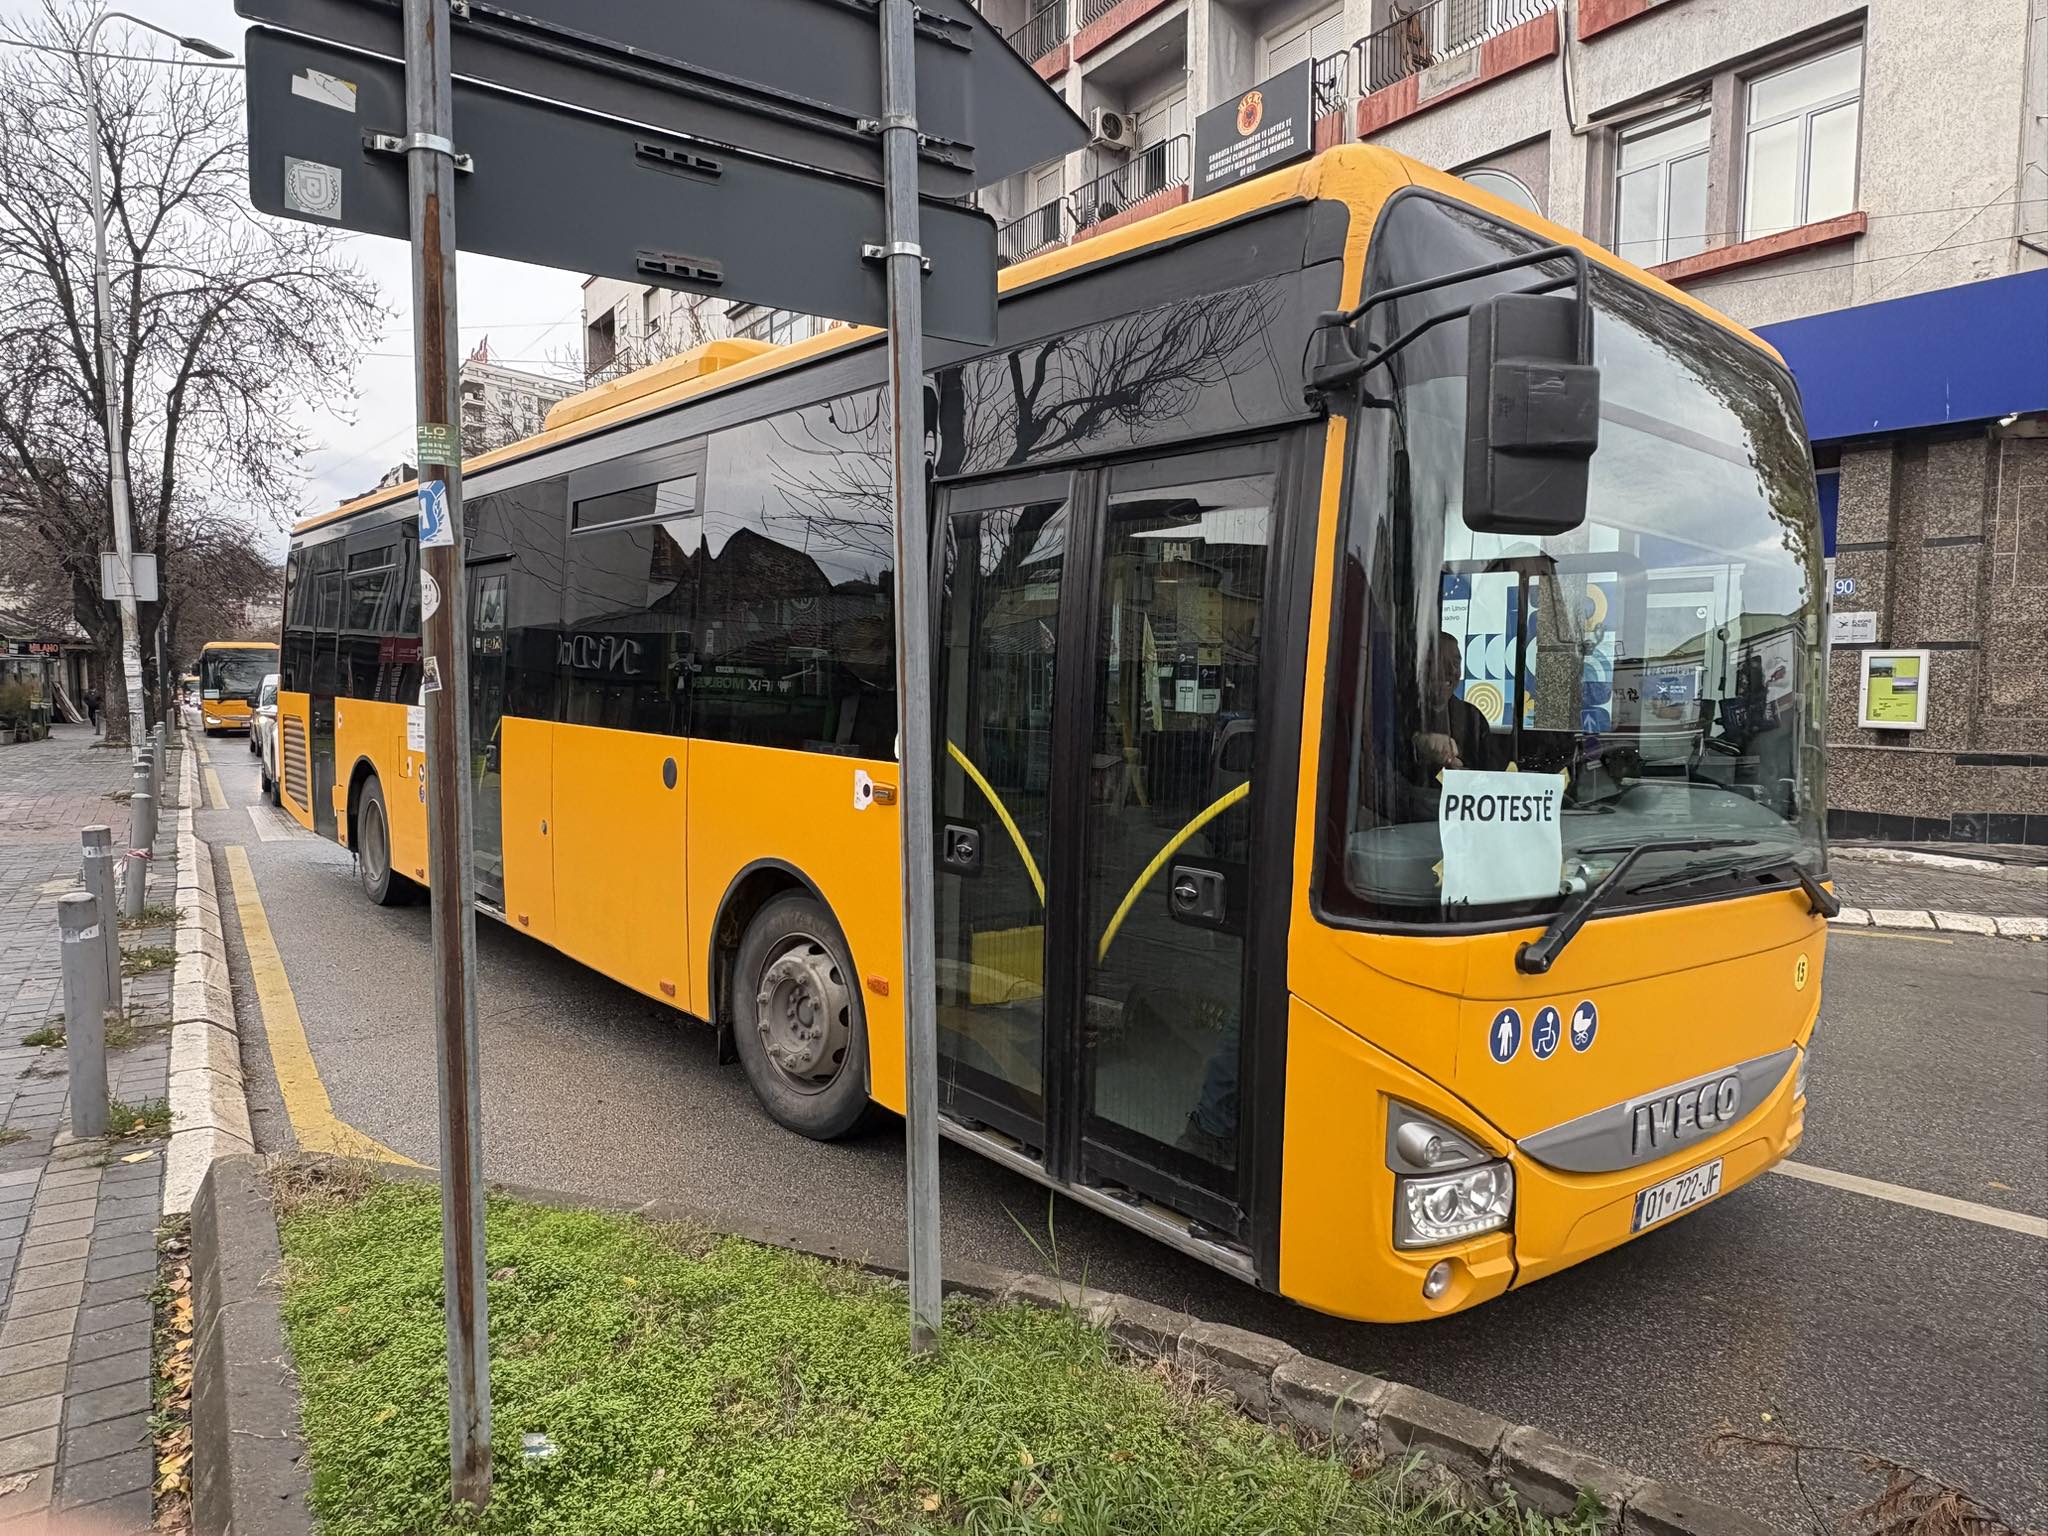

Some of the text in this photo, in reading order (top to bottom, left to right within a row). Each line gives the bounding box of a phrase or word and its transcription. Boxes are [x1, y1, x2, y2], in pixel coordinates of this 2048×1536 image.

[1835, 580, 1853, 594] 90
[1445, 789, 1554, 822] PROTESTË
[1797, 961, 1806, 982] 15
[1632, 1075, 1742, 1156] IVECO
[1646, 1162, 1720, 1222] 01 722-JF
